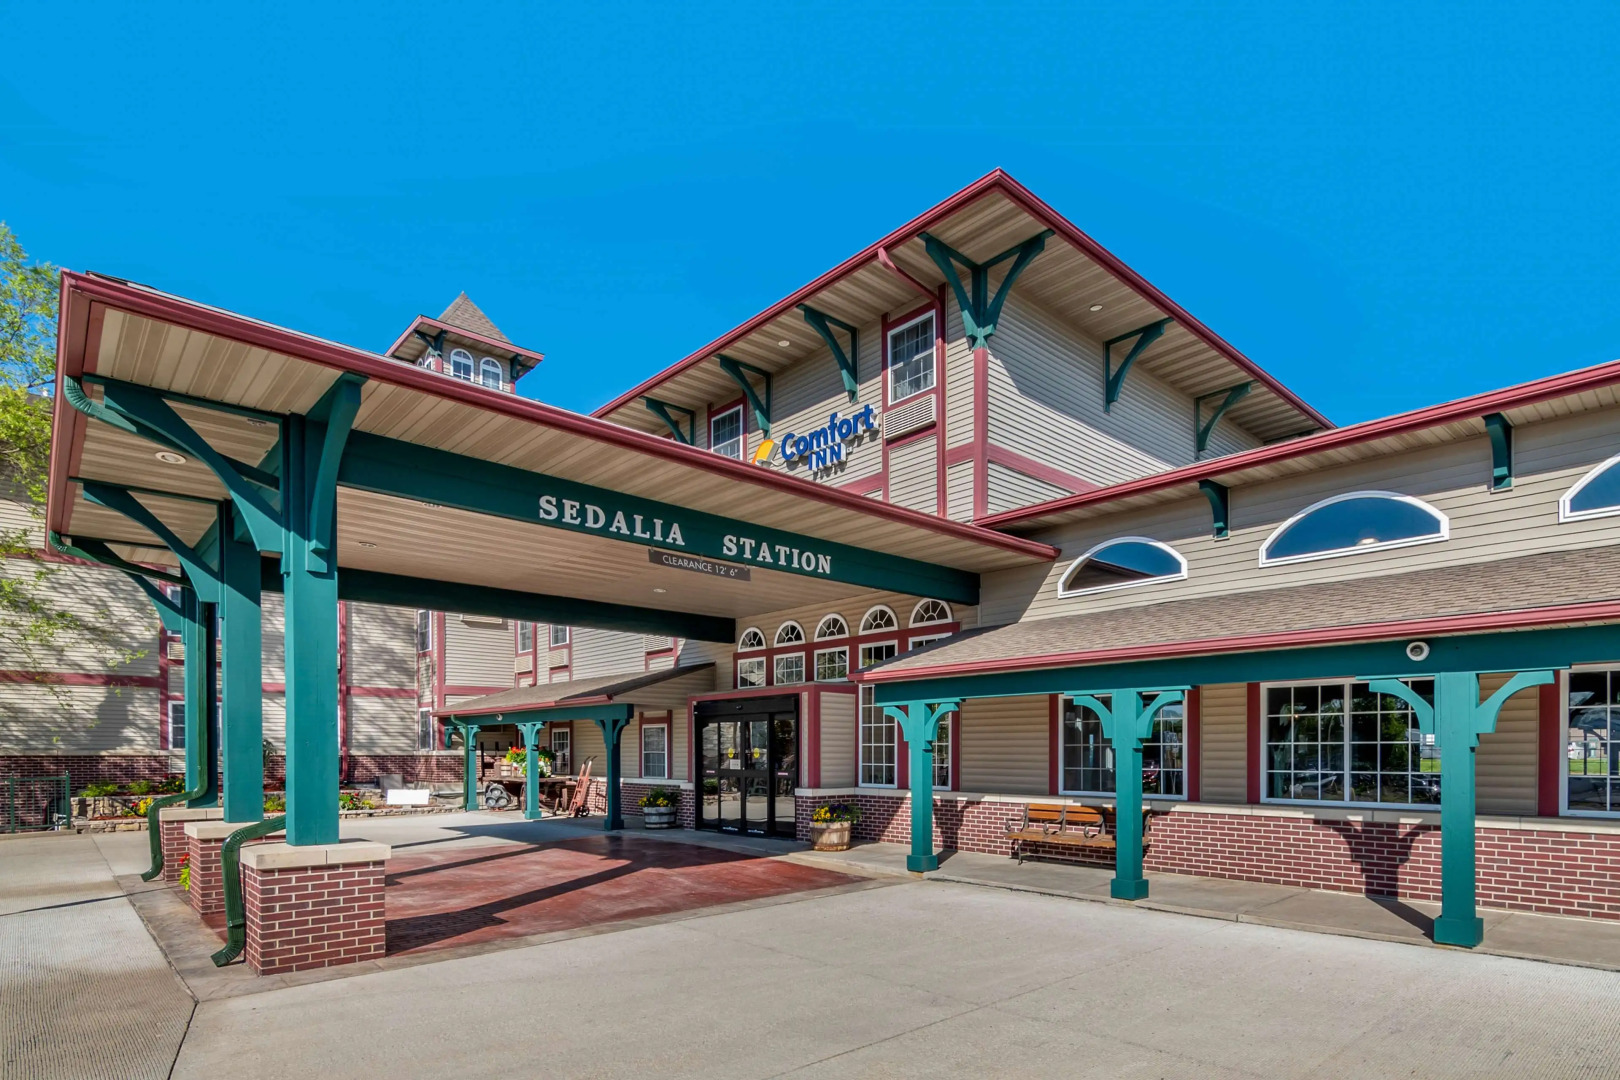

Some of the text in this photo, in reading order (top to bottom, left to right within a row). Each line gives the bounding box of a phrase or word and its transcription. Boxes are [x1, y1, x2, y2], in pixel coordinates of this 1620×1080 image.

[781, 404, 875, 461] Comfort
[808, 442, 842, 470] INN
[539, 495, 831, 574] SEDALIA STATION
[662, 556, 713, 573] CLEARANCE
